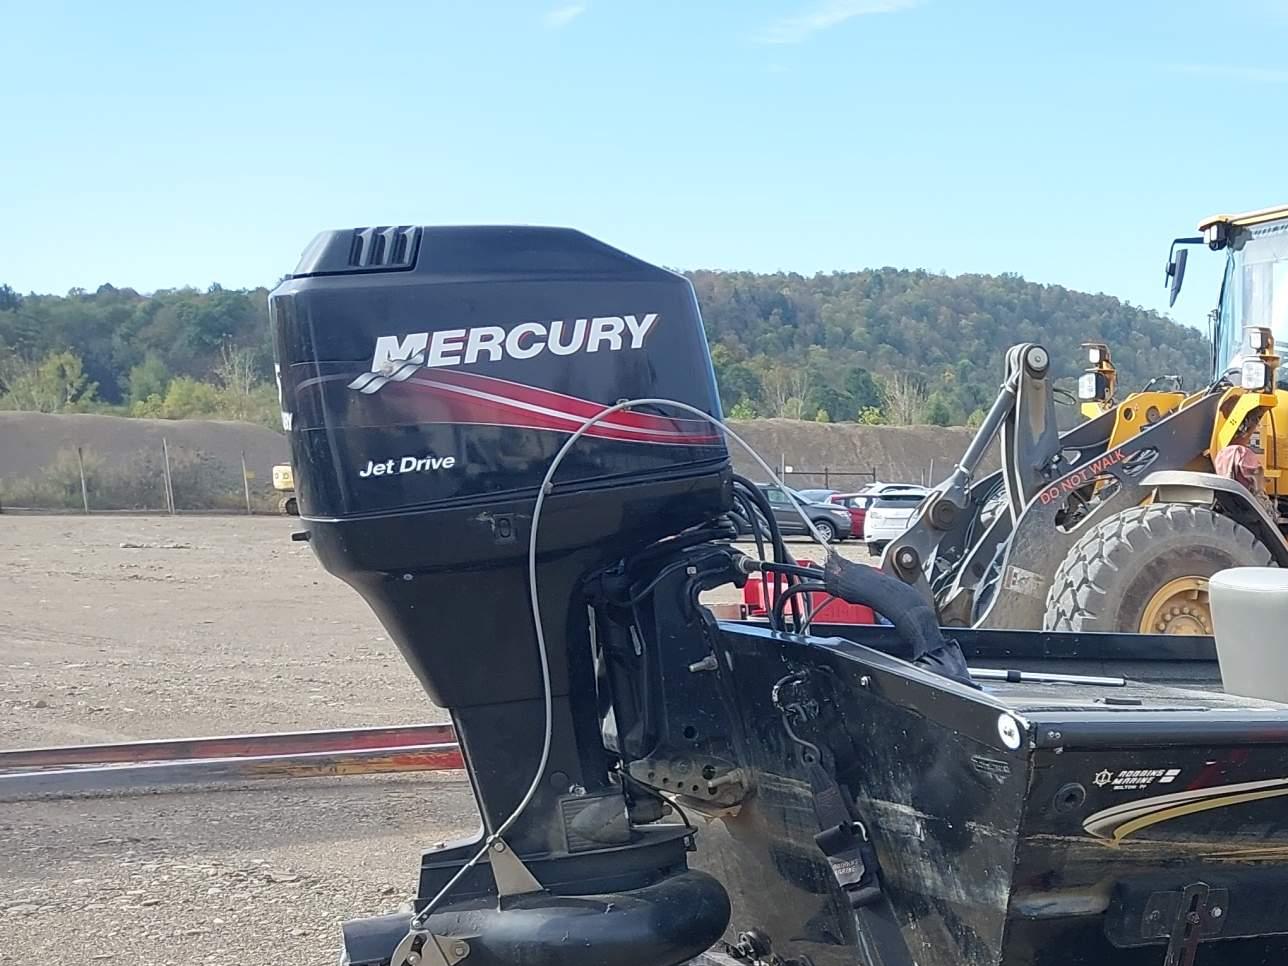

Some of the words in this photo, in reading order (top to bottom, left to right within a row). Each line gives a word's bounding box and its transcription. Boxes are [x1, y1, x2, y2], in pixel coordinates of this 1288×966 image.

[371, 313, 658, 377] MERCURY
[359, 459, 396, 477] Jet
[399, 455, 456, 473] Drive
[1040, 487, 1060, 505] DO
[1061, 469, 1088, 492] NOT
[1089, 449, 1125, 474] WALK
